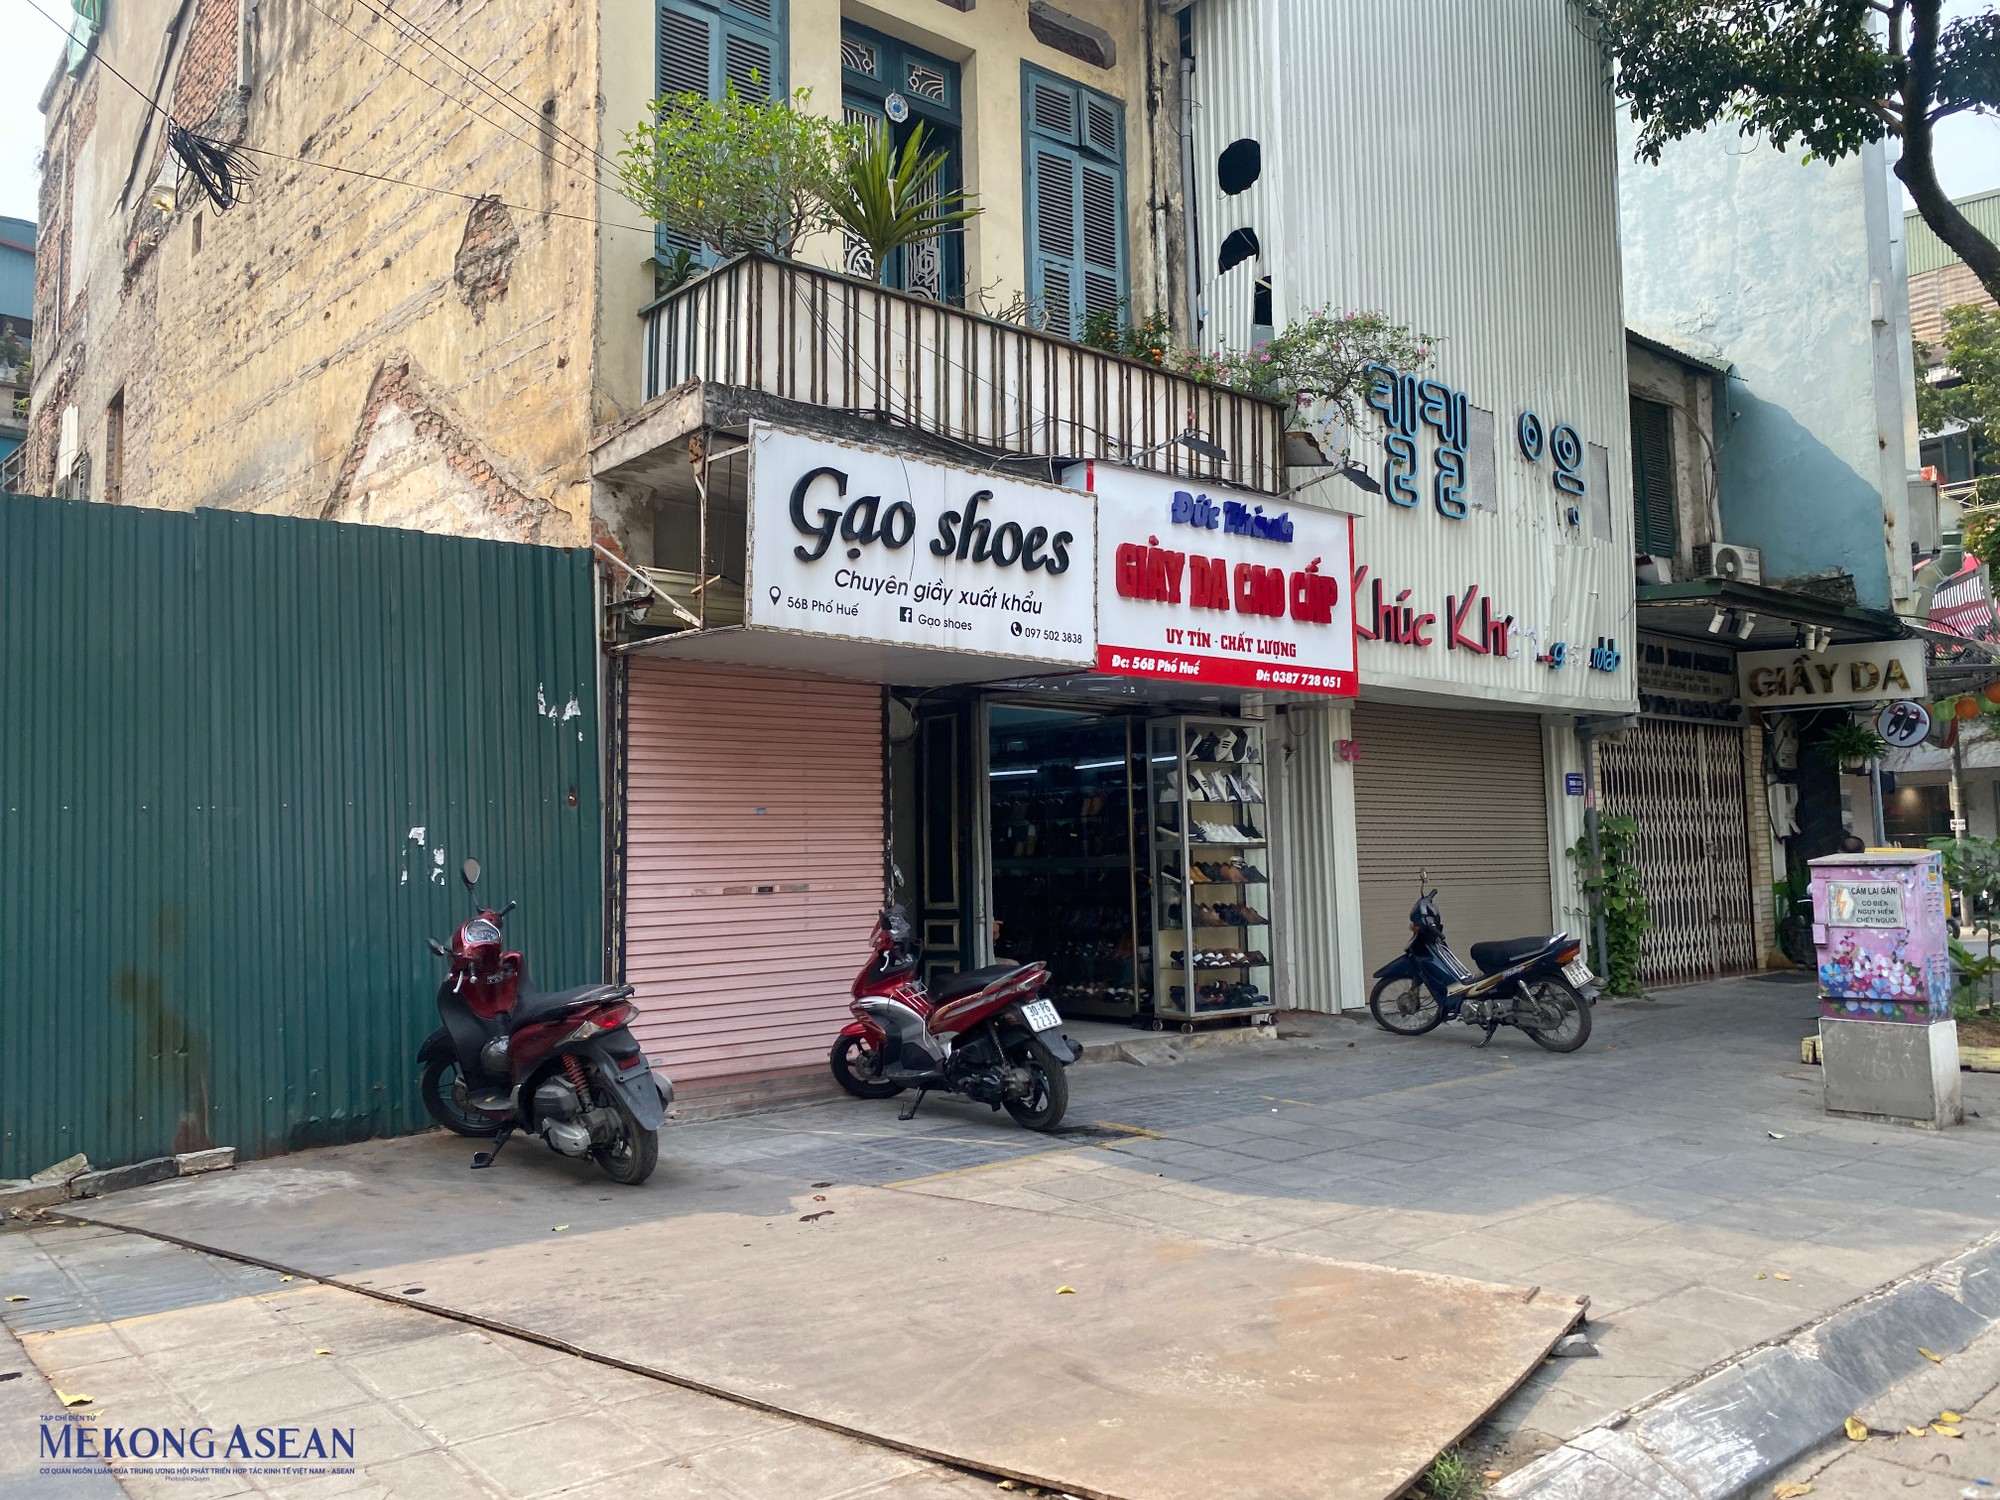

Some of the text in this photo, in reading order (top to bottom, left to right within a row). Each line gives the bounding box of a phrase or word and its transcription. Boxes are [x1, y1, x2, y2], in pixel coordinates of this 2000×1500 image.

[789, 466, 1074, 575] Gạo shoes
[1171, 490, 1221, 530] Đức
[834, 568, 1043, 615] Chuyên giầy xuất khẩu
[1189, 554, 1230, 611] DA
[1233, 563, 1286, 618] CAO
[1289, 556, 1338, 625] CẤP
[787, 596, 860, 616] 56B Phố Huế
[917, 614, 973, 631] Gạo shoes
[1024, 626, 1083, 645] 097 502 3838
[1166, 628, 1184, 645] UY
[1187, 628, 1211, 649] TÍN
[1220, 631, 1254, 653] CHẤT
[1256, 639, 1297, 659] LƯỢNG
[1111, 654, 1201, 676] Đc: 56B Phố Huế
[1851, 659, 1911, 693] DA
[1272, 671, 1300, 686] 0387
[1301, 673, 1322, 687] 728
[1322, 675, 1342, 689] 051
[1033, 1013, 1058, 1029] 2233
